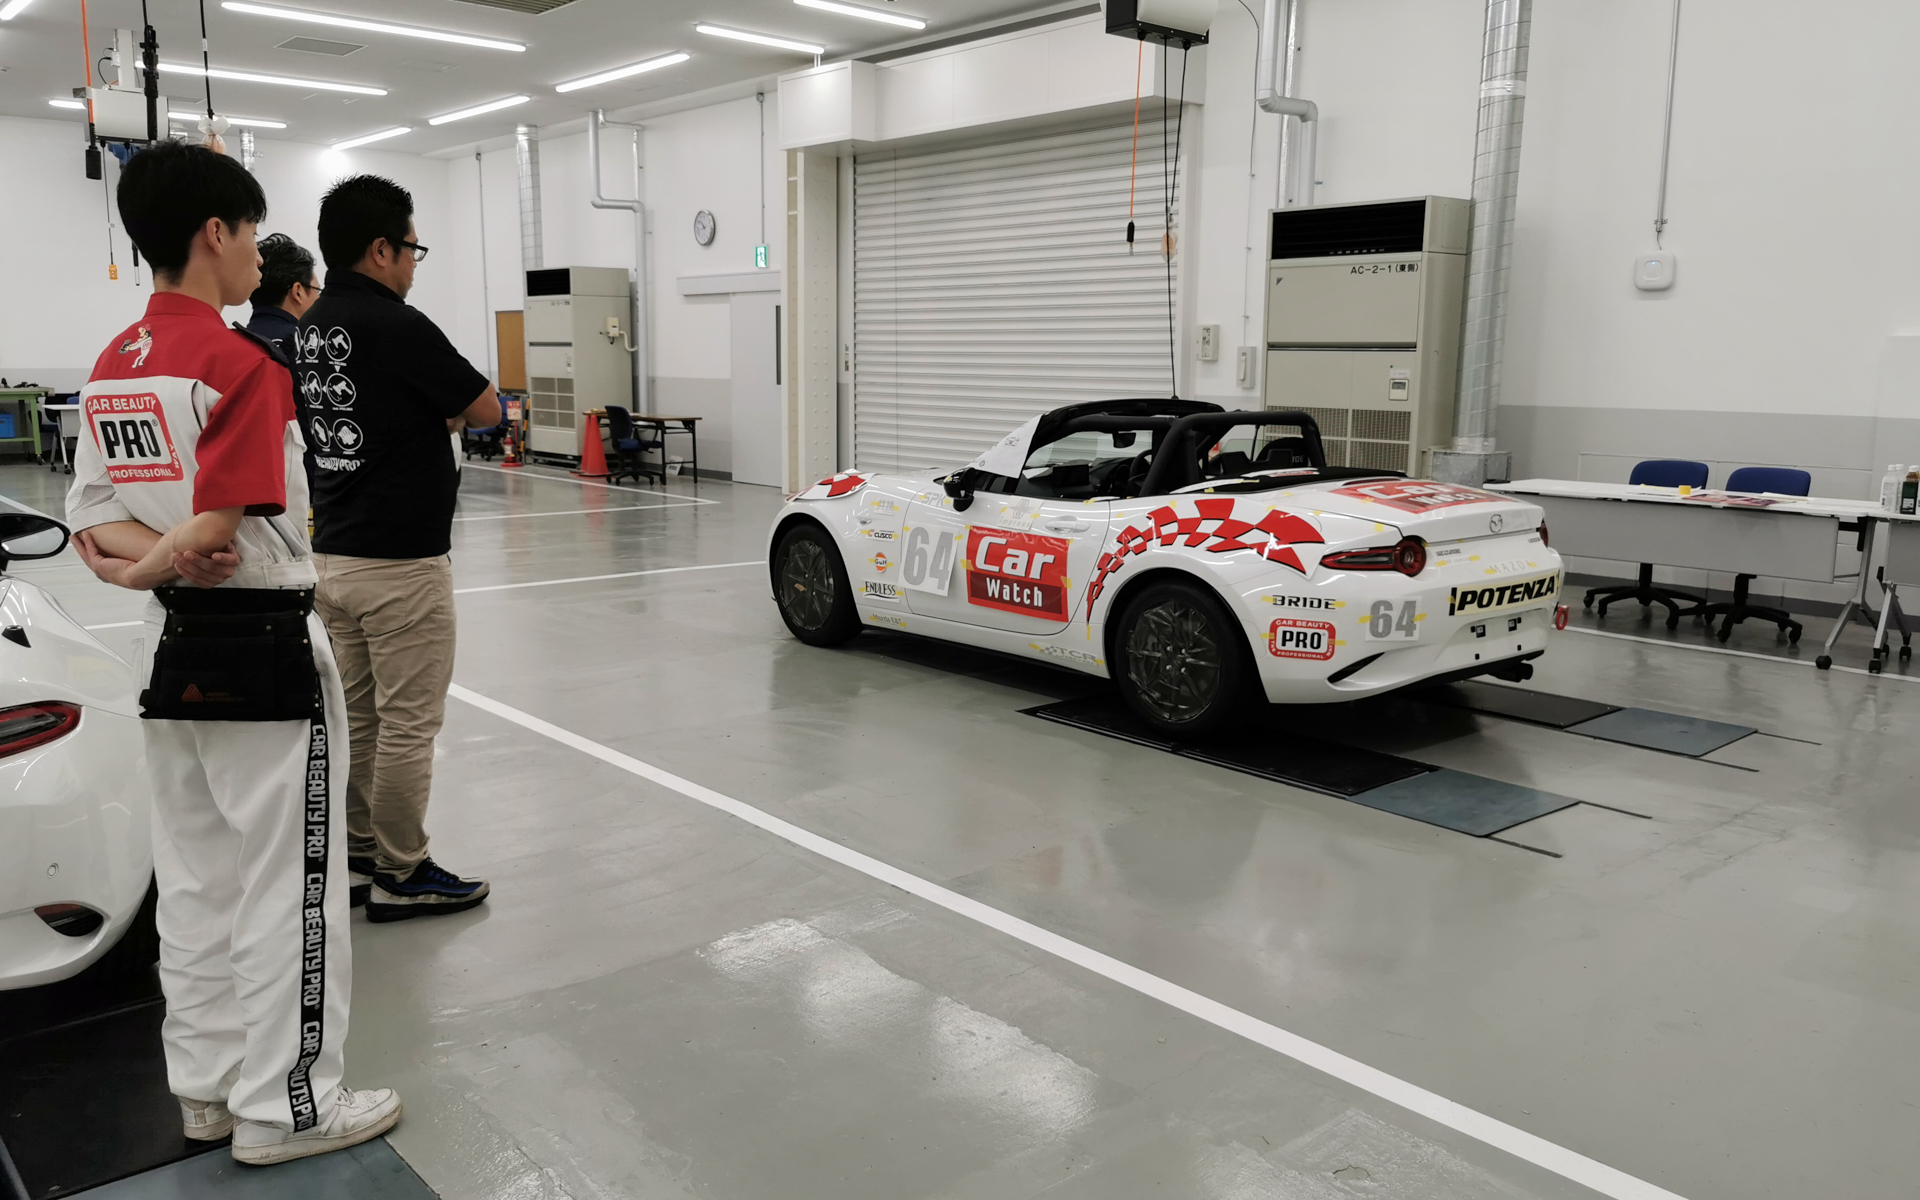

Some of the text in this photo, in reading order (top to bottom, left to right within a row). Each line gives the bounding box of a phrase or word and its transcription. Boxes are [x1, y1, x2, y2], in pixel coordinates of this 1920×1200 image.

[88, 396, 157, 414] CAR BEAUTY
[169, 443, 180, 469] WAY
[110, 468, 176, 479] PROFESSIONAL
[921, 491, 947, 507] SPK
[903, 527, 954, 591] 64
[975, 536, 1056, 580] Car
[1489, 560, 1535, 574] MAZDA
[865, 581, 897, 596] ENDLESS
[986, 577, 1043, 607] Watch
[1272, 595, 1336, 610] BRIDE
[1457, 575, 1555, 611] POTENZA
[1296, 620, 1330, 629] BEAUTY
[1369, 600, 1417, 639] 64
[1277, 651, 1325, 659] PROFESSIONAL
[311, 724, 327, 758] CAR
[307, 759, 326, 822] BEAUTY
[304, 872, 324, 906] CAR
[304, 906, 323, 971] BEAUTY
[302, 1020, 320, 1056] CAR
